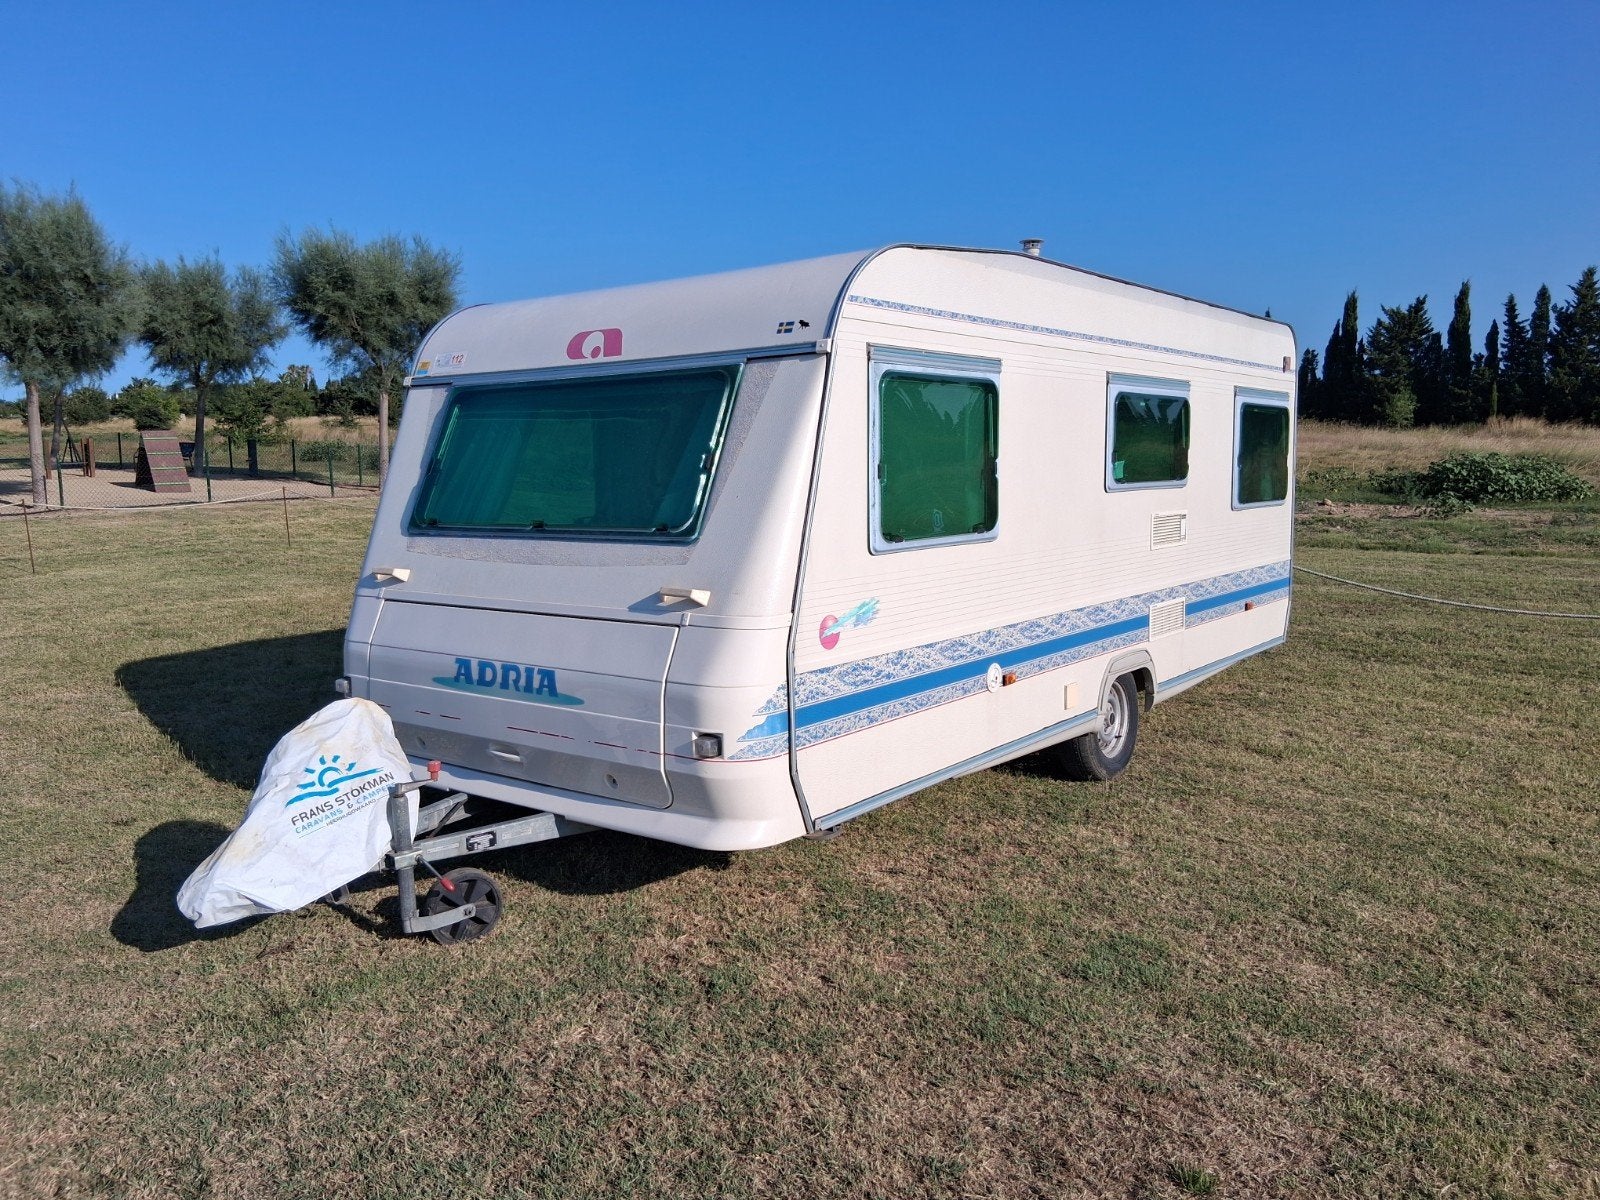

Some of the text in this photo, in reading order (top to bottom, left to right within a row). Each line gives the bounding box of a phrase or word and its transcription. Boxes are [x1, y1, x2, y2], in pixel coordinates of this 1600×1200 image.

[454, 657, 558, 697] ADRIA
[291, 772, 395, 826] FRANS STOKMAN
[295, 809, 343, 834] CARAVANS
